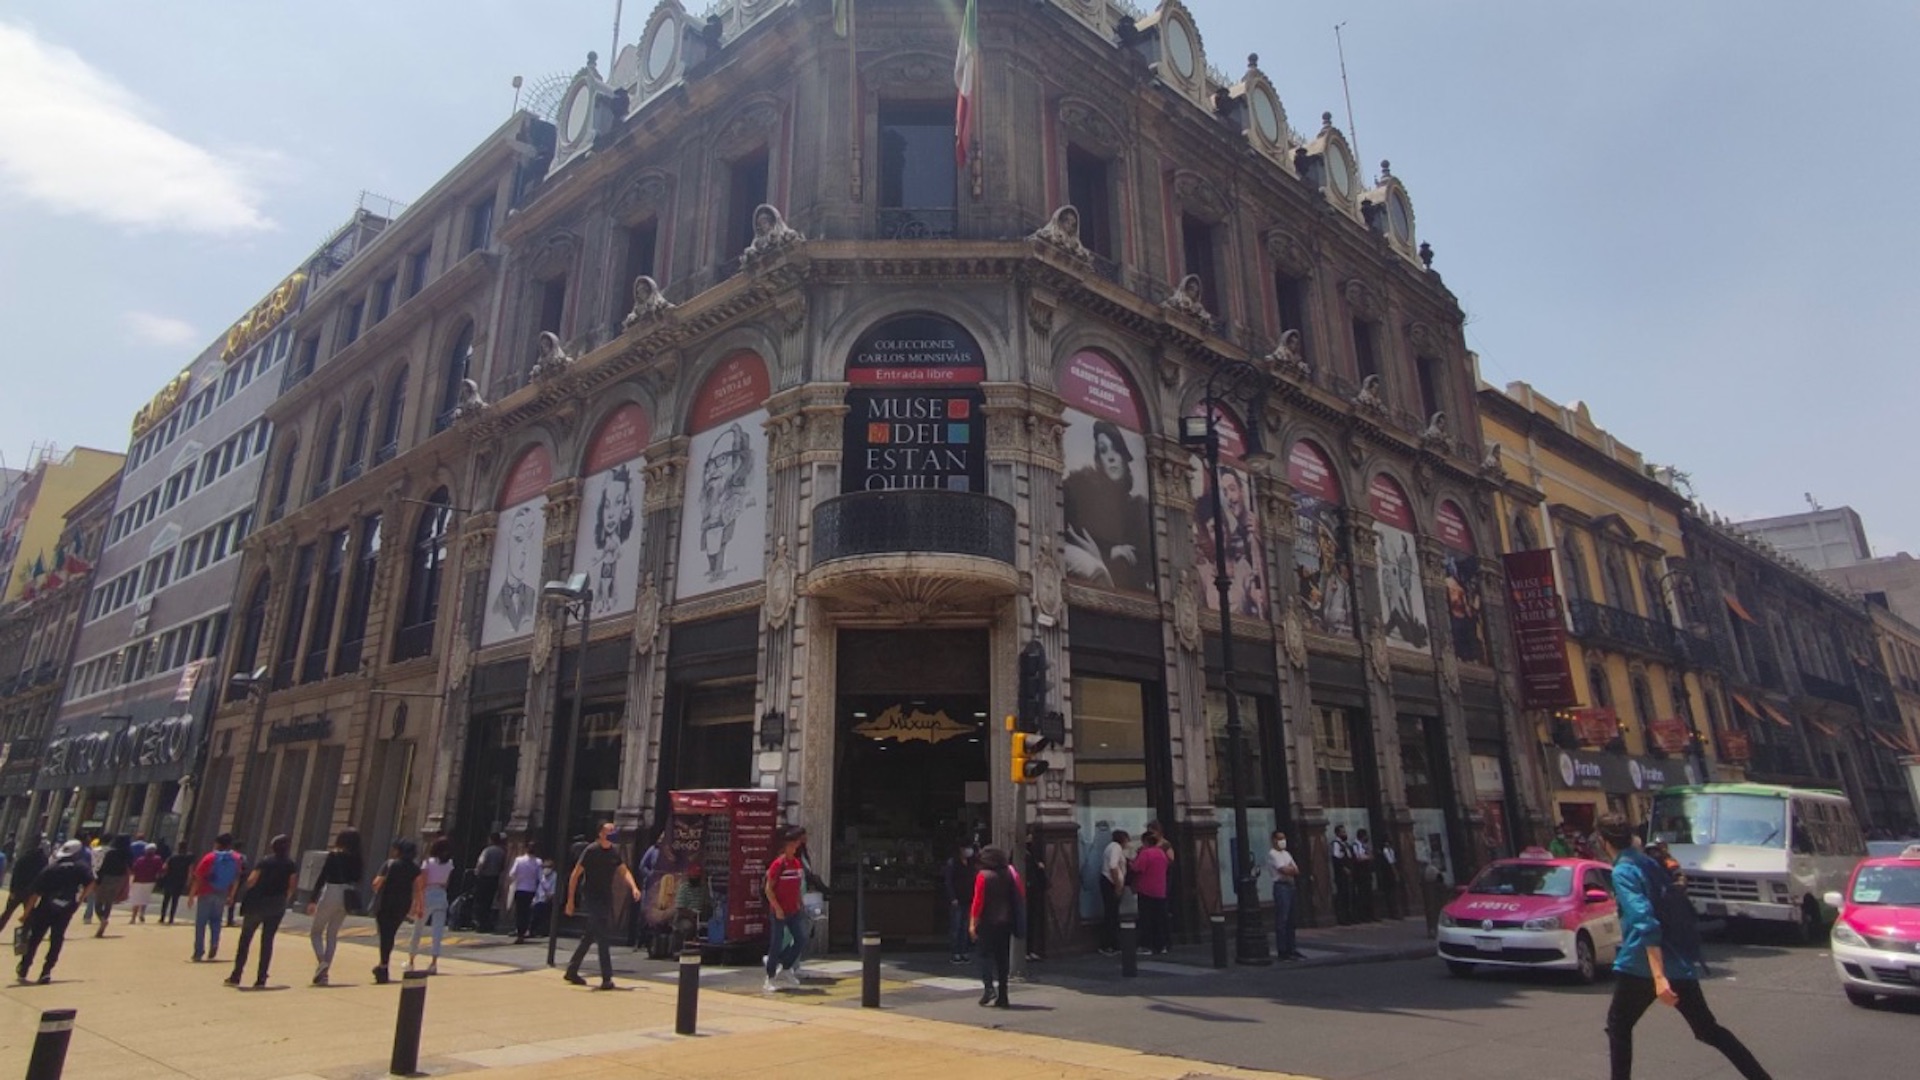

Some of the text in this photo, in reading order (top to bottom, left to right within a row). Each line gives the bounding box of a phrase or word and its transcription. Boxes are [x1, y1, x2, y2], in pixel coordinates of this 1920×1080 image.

[875, 340, 955, 351] COLECCIONES
[858, 353, 905, 363] CARLOS
[876, 369, 954, 380] Entrada libre
[895, 423, 945, 444] DEL
[866, 448, 967, 470] ESTAN
[888, 714, 941, 738] Mixup
